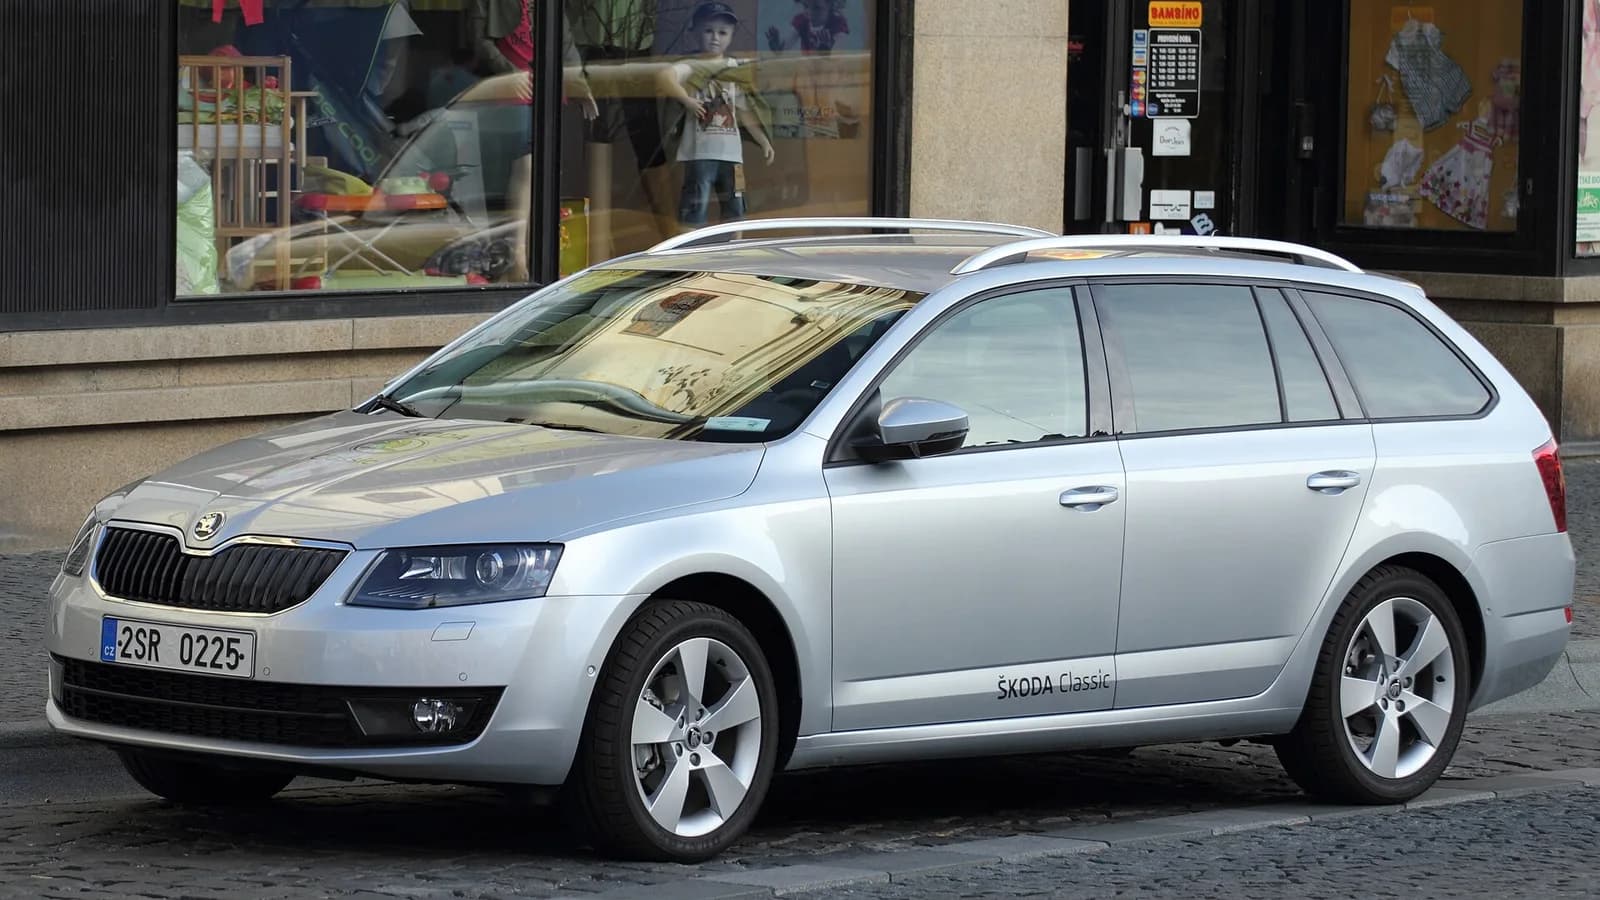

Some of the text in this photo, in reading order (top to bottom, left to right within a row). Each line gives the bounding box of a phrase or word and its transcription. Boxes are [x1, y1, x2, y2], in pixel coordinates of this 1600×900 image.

[1151, 4, 1200, 20] BAMBÍNO
[104, 646, 115, 656] CZ
[120, 626, 240, 670] 2SR 0225
[997, 668, 1110, 700] ŠKODA Classic
